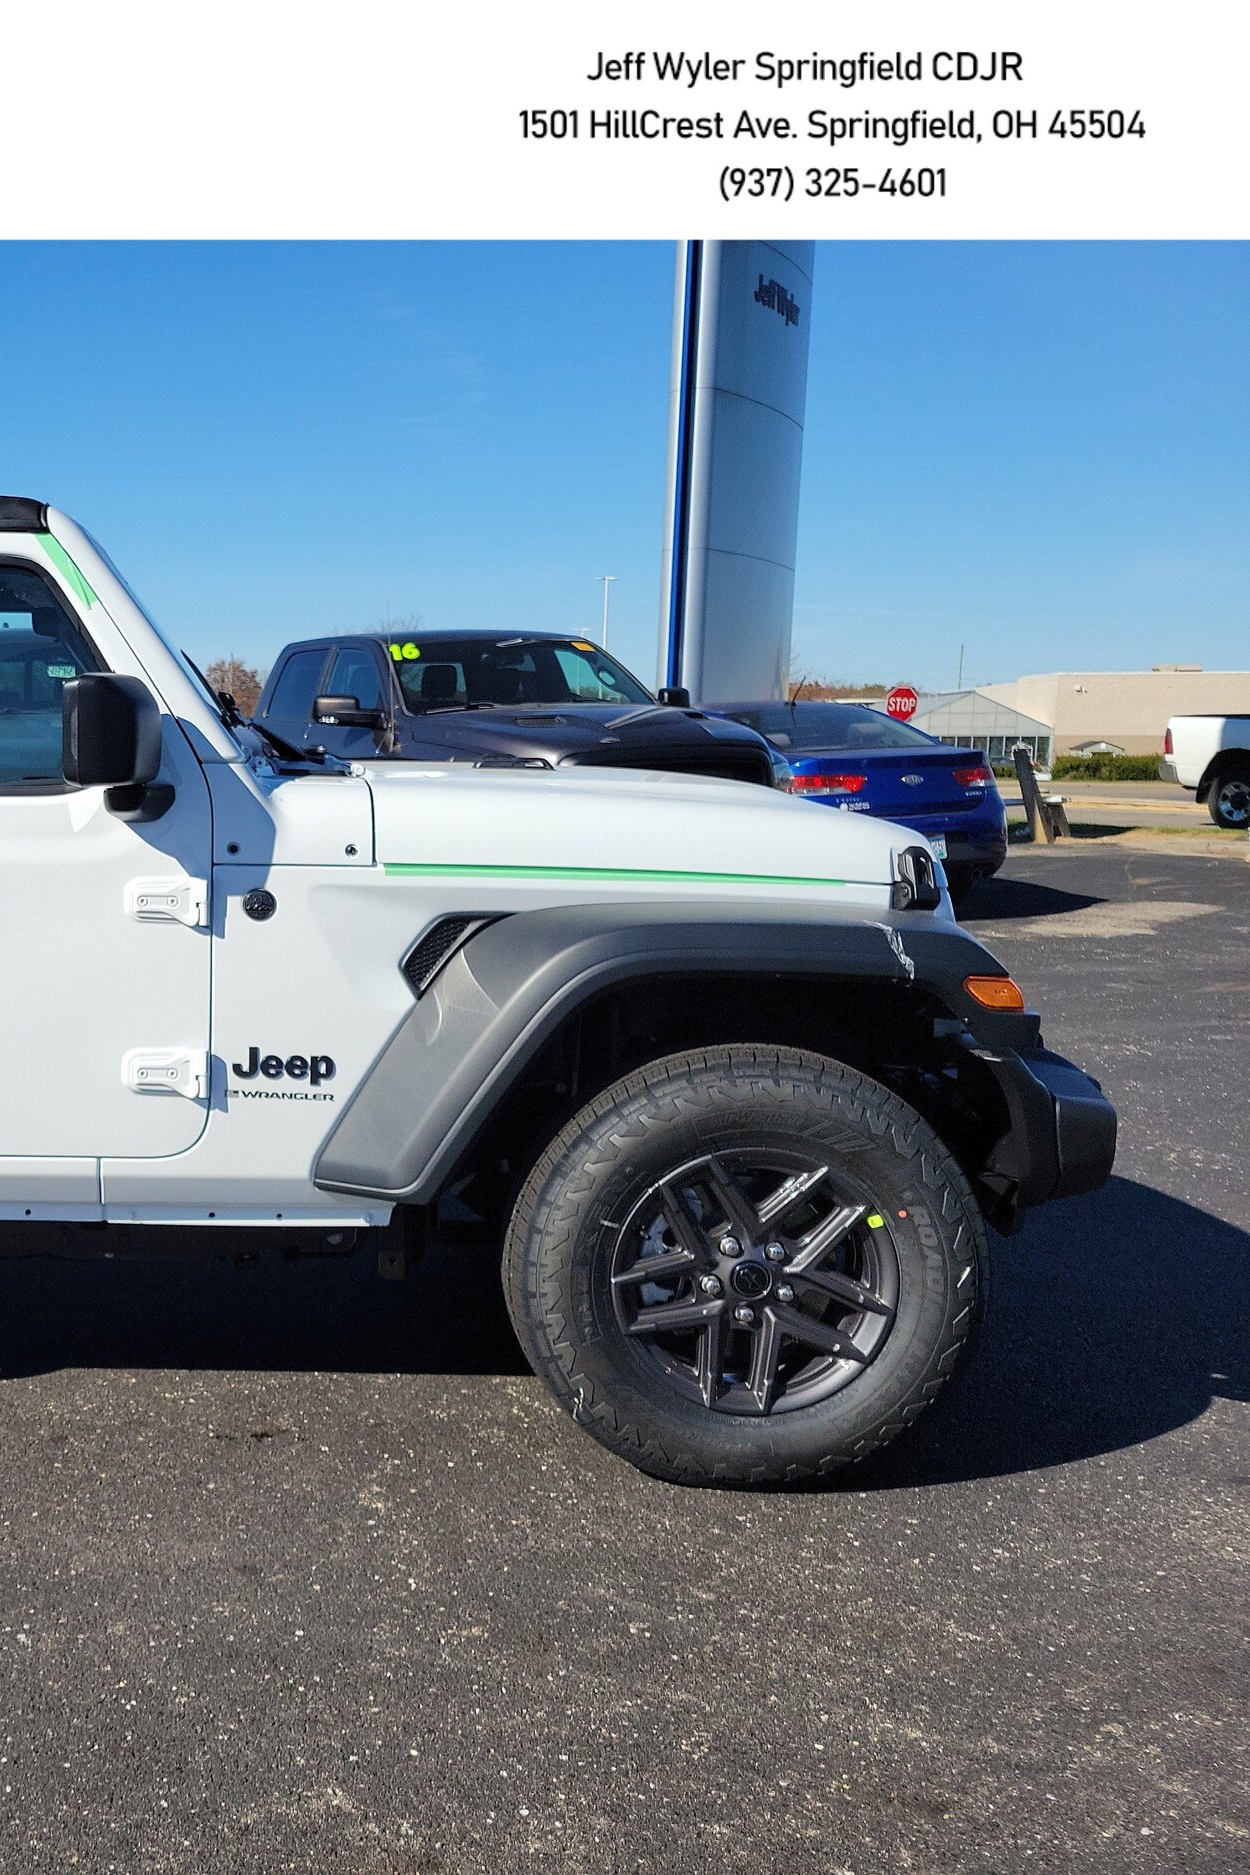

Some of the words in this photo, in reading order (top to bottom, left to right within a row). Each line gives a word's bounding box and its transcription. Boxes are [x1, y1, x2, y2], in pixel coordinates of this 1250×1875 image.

[389, 642, 421, 661] 16
[888, 696, 917, 713] STOP
[232, 1046, 337, 1088] Jeep
[241, 1090, 335, 1102] WRANGLER
